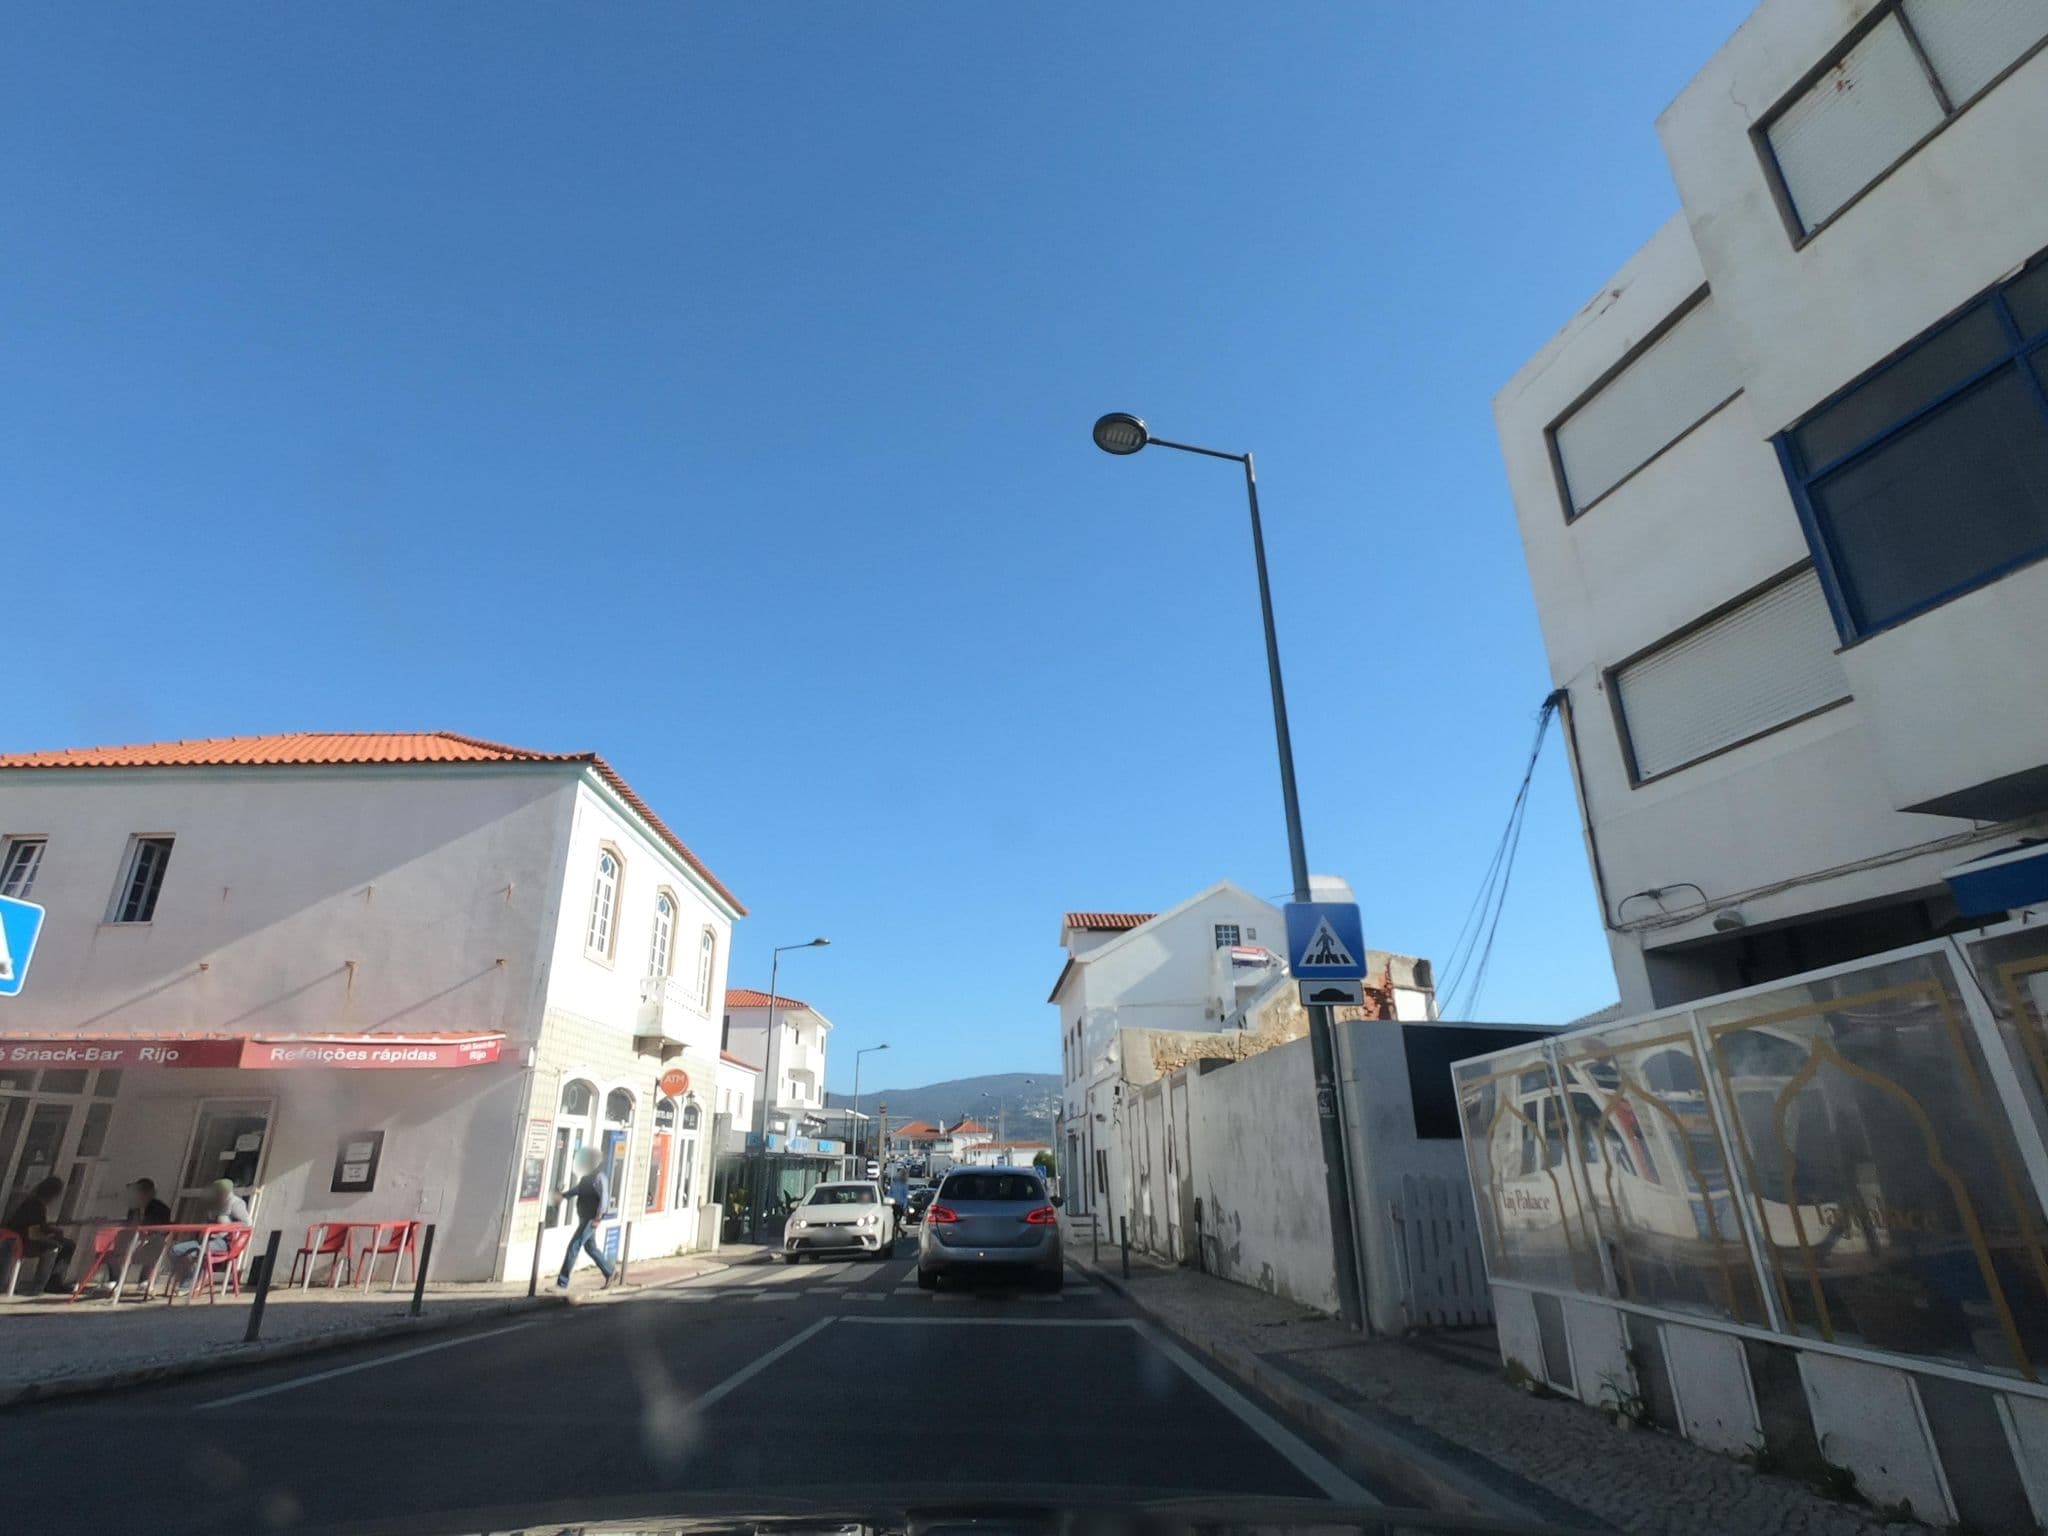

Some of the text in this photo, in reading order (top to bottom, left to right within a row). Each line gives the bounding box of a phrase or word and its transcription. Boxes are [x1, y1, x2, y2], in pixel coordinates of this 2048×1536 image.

[11, 1047, 124, 1061] Snack-Bar
[138, 1047, 180, 1063] Rijo
[270, 1047, 438, 1063] Refeições rápidas
[664, 1073, 685, 1084] ATM
